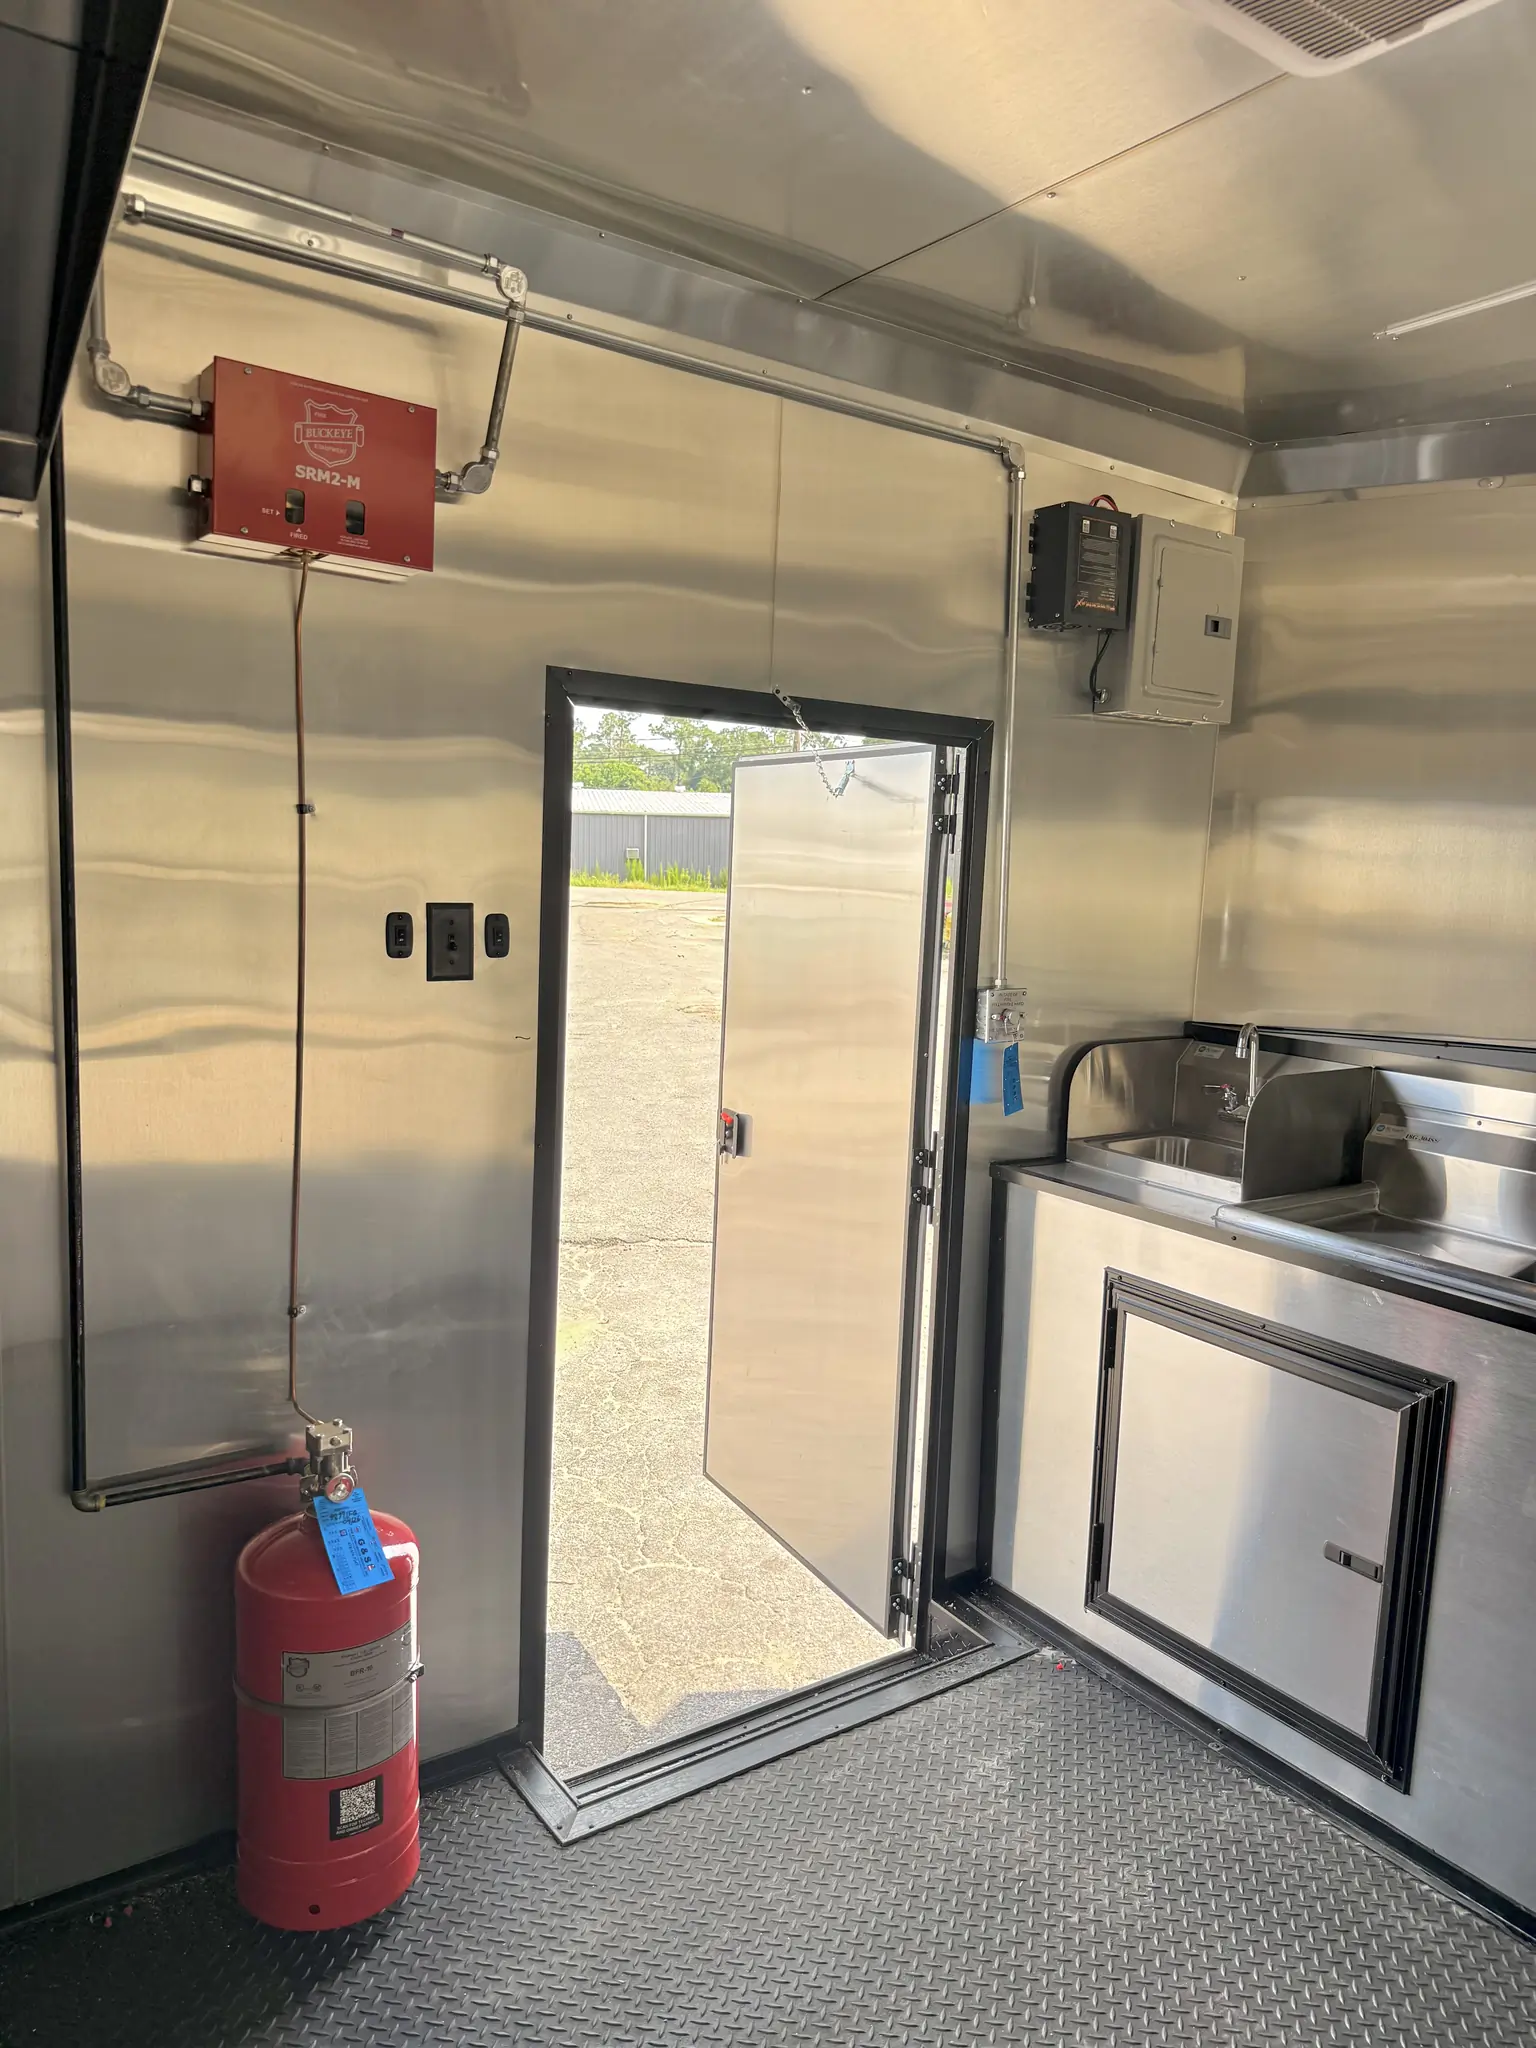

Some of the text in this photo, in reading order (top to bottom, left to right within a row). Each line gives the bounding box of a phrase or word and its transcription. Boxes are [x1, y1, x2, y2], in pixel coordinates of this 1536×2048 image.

[306, 427, 353, 439] BUCKEYE
[295, 464, 361, 490] SRM2-M
[261, 507, 274, 515] SET
[289, 532, 308, 541] FIRED
